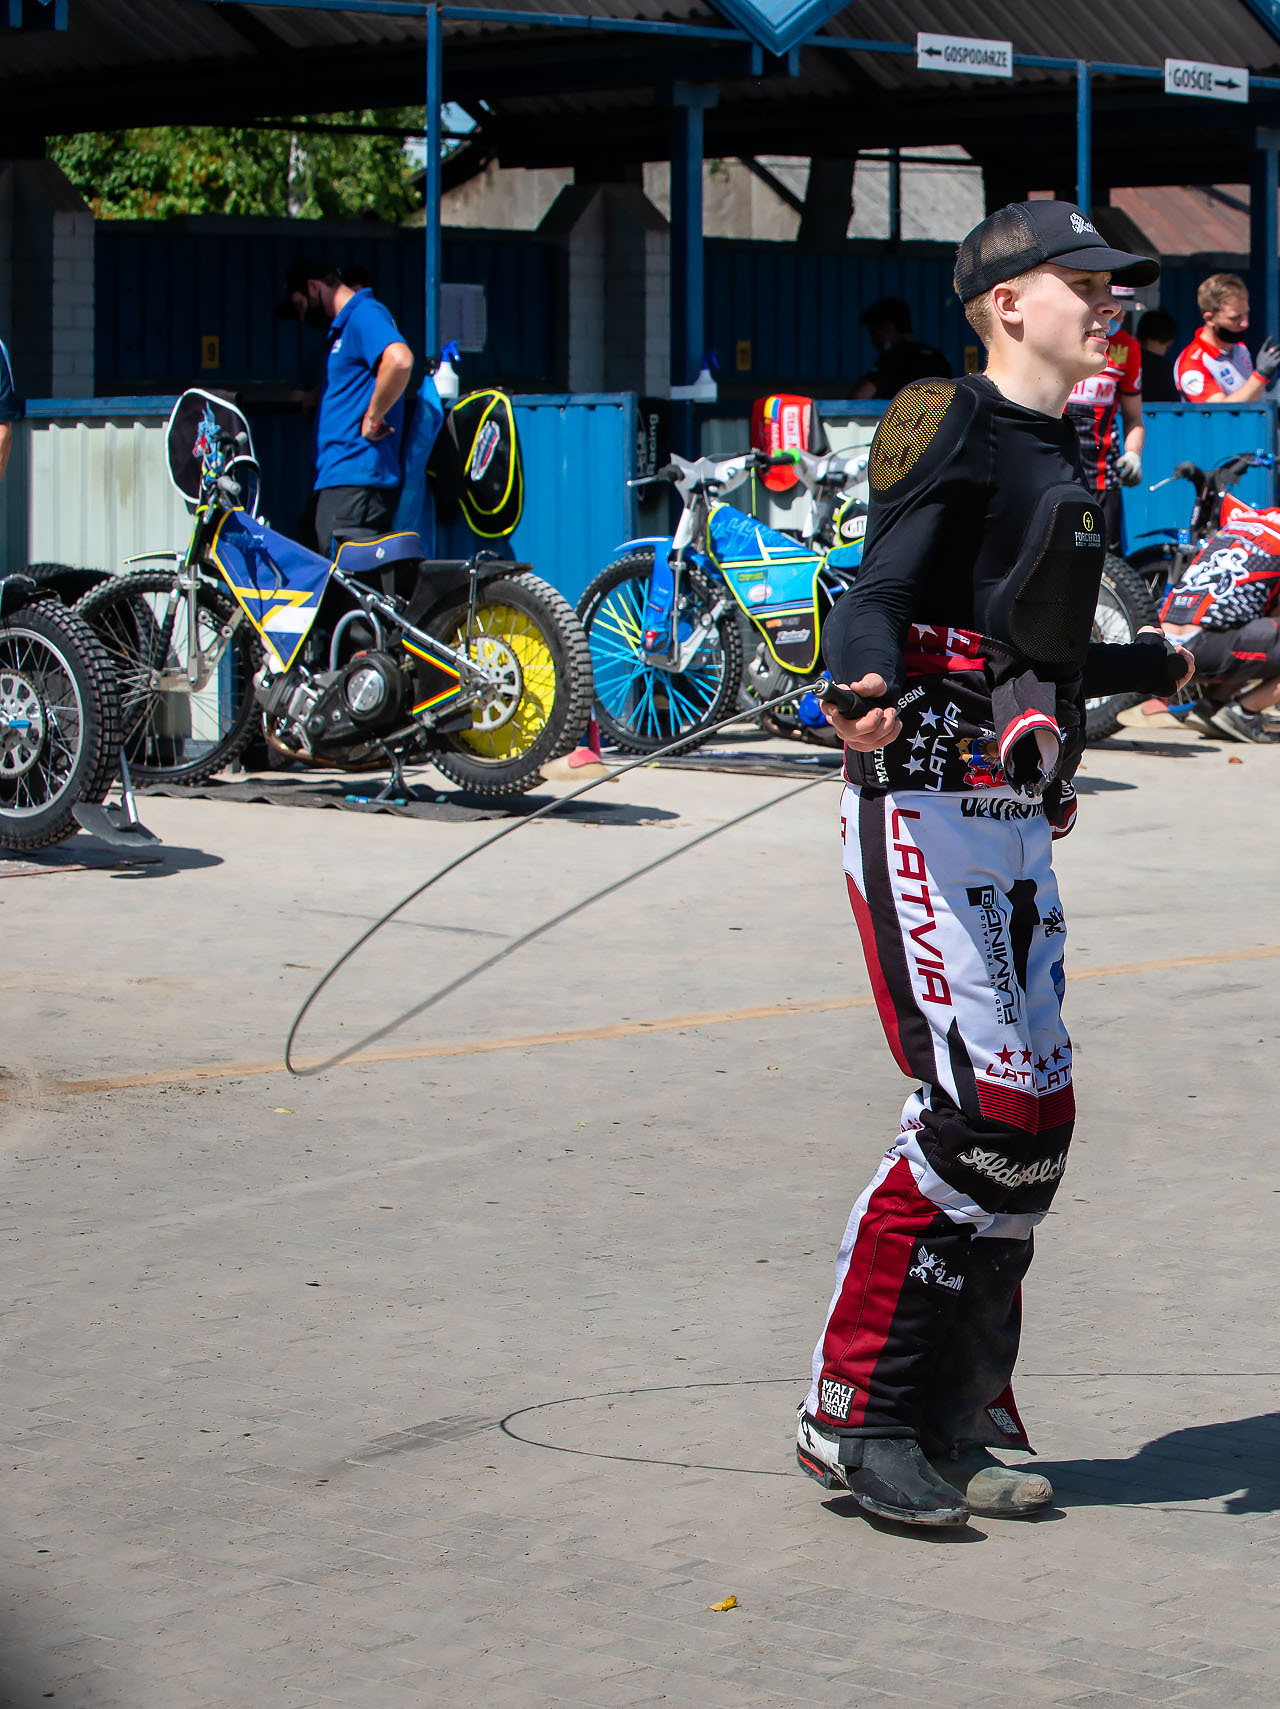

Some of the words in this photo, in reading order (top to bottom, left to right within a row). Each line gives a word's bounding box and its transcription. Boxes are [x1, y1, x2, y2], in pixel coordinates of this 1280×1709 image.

[943, 46, 1008, 68] GOSPODARZE
[1172, 65, 1213, 91] GOŚCIE
[647, 413, 659, 476] Racing
[1074, 531, 1101, 542] FORCEFIELD
[897, 685, 926, 709] SGN
[924, 701, 962, 792] LATVIA
[891, 808, 953, 1007] LATVIA
[979, 909, 994, 967] TELPAUGI
[989, 973, 997, 987] UN
[993, 993, 1004, 1025] ZIEDI
[821, 1379, 855, 1398] MALI
[821, 1390, 851, 1409] NIAK
[825, 1402, 850, 1419] SGN
